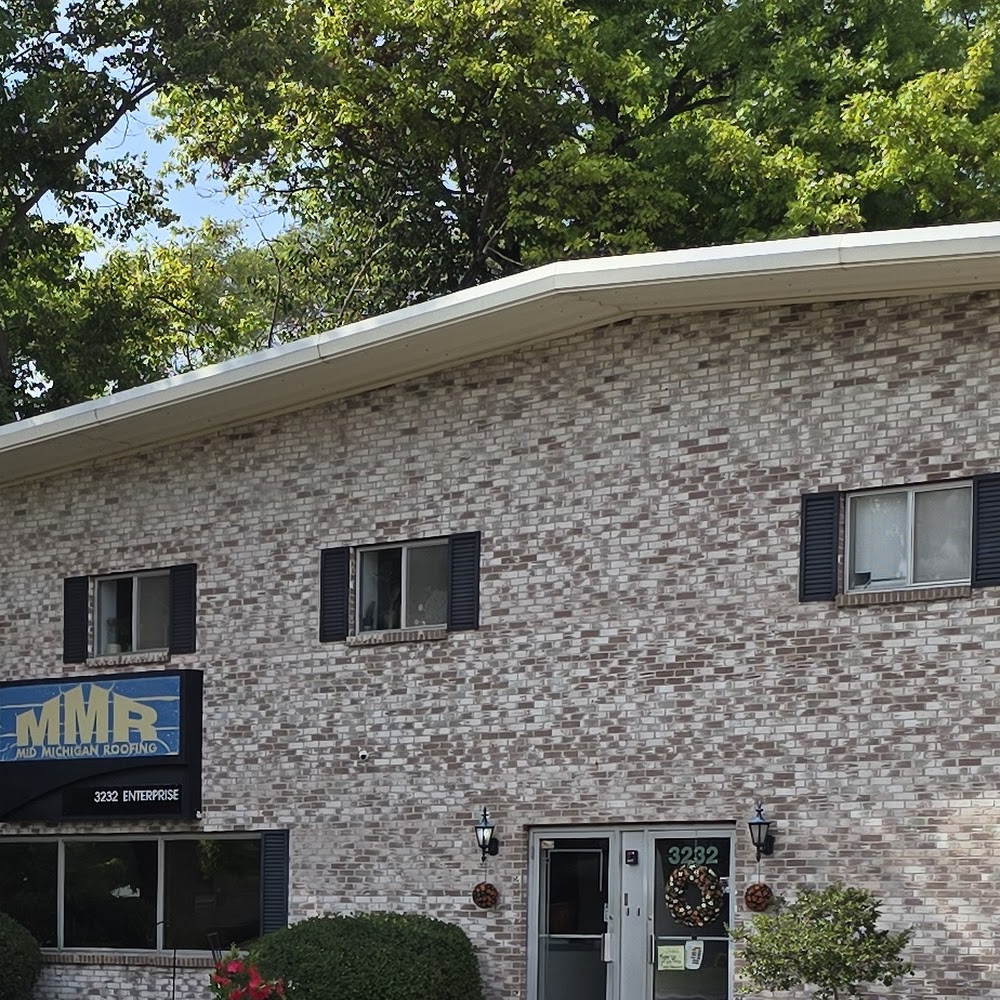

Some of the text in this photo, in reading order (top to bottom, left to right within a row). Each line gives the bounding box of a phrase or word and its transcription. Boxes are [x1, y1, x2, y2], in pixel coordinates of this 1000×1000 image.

[16, 683, 158, 745] MMR
[16, 742, 157, 759] MID MICHIGAN ROOFING
[94, 789, 179, 802] 3232 ENTERPRISE
[668, 846, 719, 865] 3232
